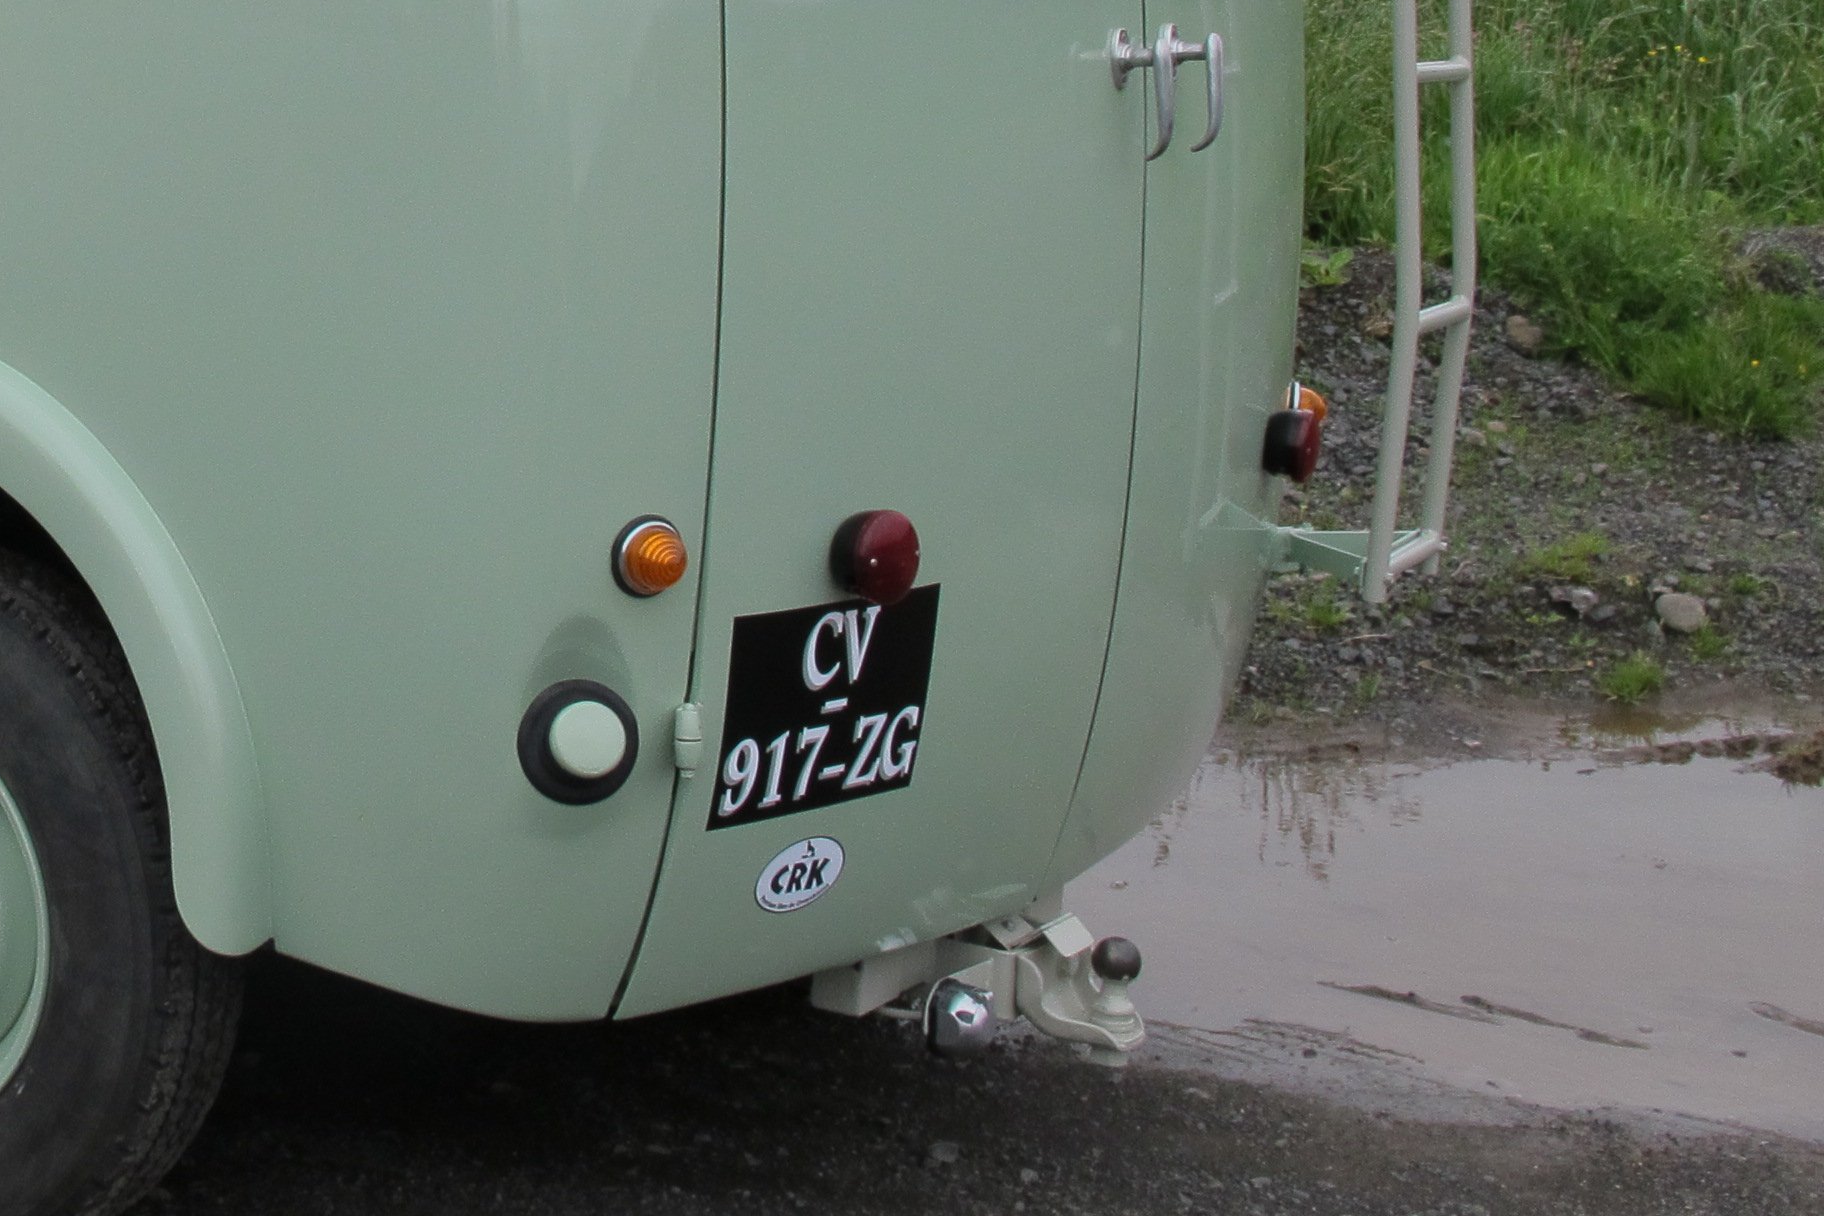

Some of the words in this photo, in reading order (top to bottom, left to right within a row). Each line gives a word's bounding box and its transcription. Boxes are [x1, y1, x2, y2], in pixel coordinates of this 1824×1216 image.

[802, 605, 882, 691] CV
[717, 705, 920, 817] 917-ZG
[770, 857, 831, 895] CRK
